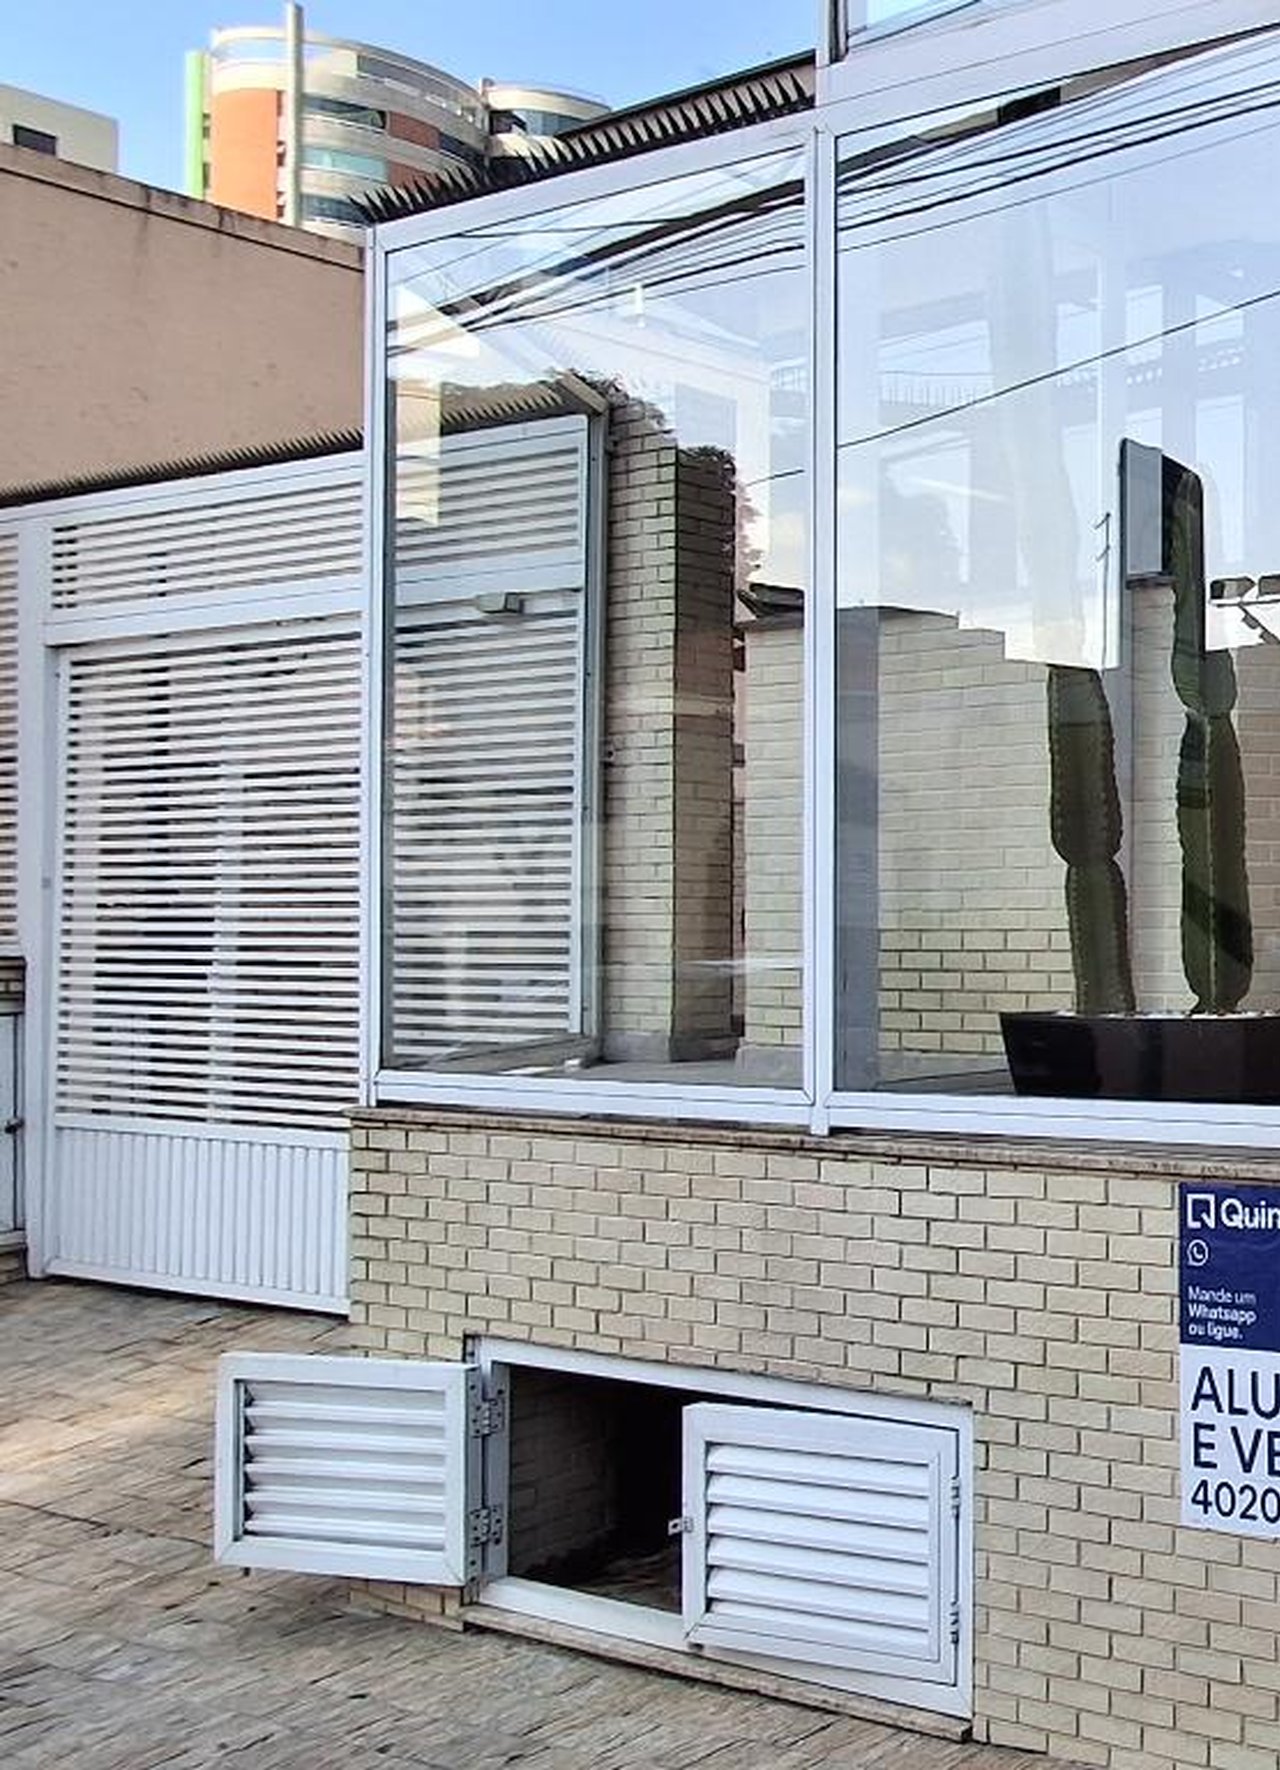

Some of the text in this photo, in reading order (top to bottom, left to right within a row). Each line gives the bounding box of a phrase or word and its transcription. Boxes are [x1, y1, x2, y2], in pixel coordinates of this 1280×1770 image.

[1188, 1285, 1233, 1303] Mande
[1188, 1302, 1257, 1326] Whatsapp
[1188, 1323, 1206, 1336] ou
[1193, 1421, 1218, 1469] E
